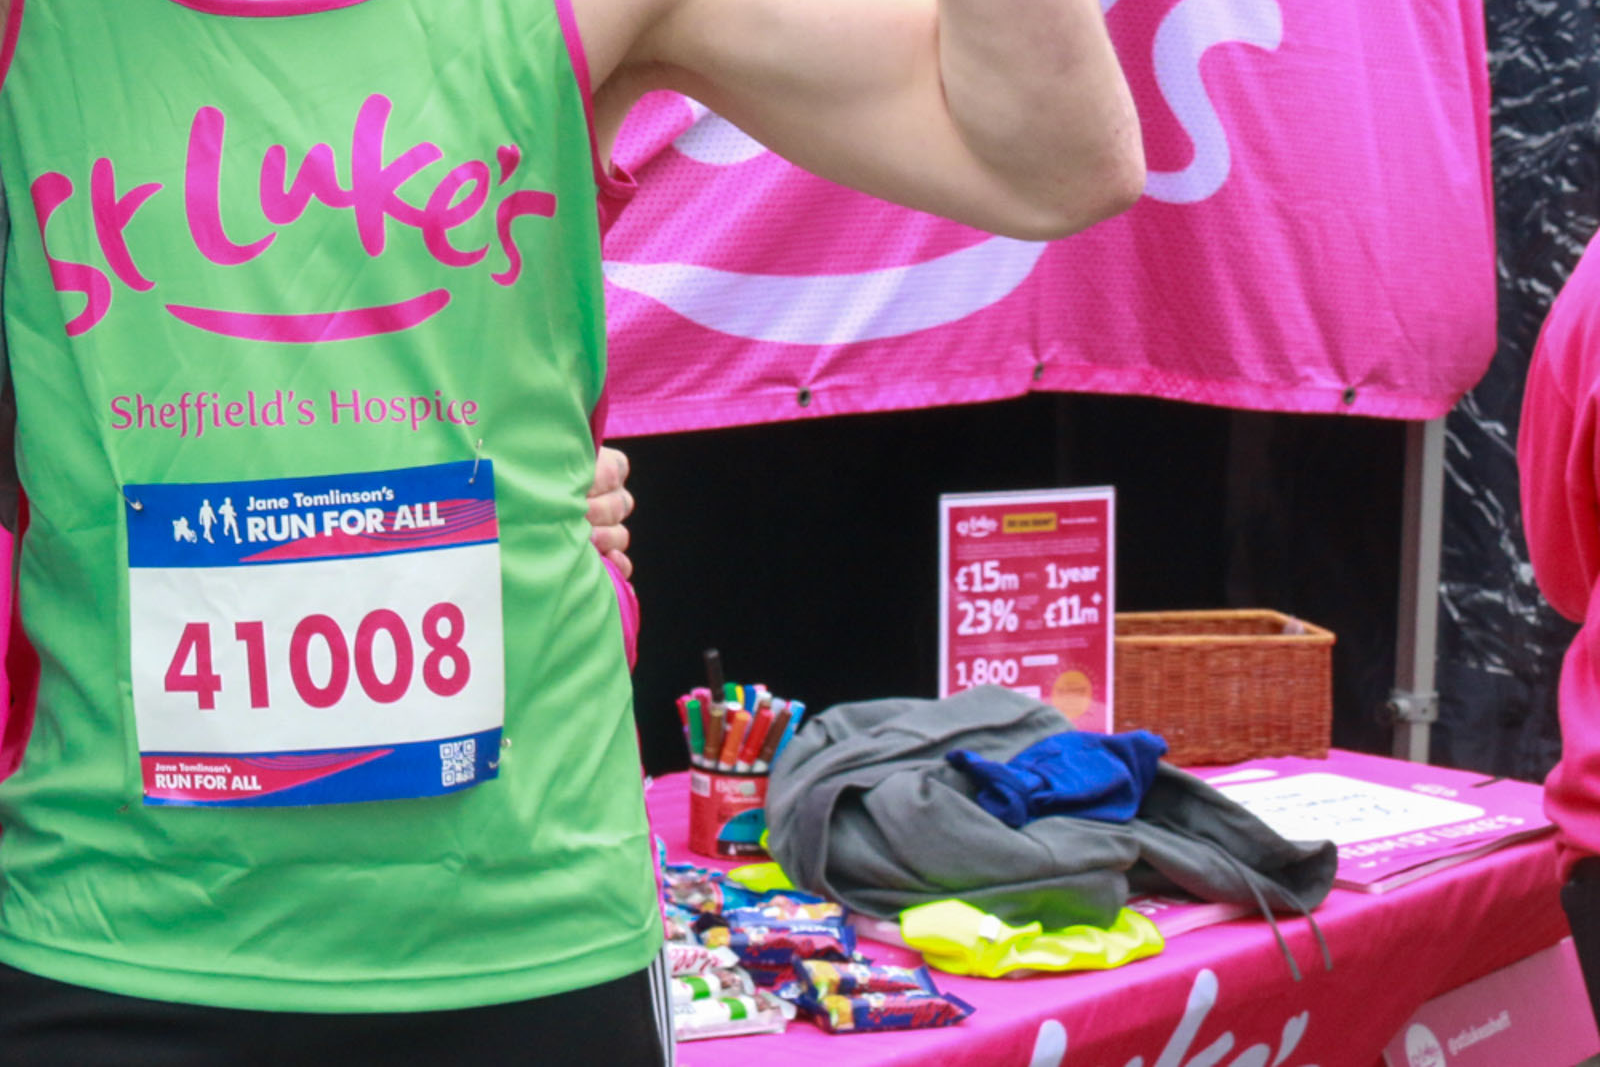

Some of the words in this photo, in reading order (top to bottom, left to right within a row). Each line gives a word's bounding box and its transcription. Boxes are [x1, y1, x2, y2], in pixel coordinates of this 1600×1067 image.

[30, 156, 164, 338] St
[184, 93, 558, 287] Luke's
[110, 390, 316, 438] Sheffield's
[330, 389, 480, 432] Hospice
[246, 496, 290, 512] Jane
[293, 486, 395, 509] Tomlinson's
[246, 515, 316, 543] RUN
[323, 509, 386, 538] FOR
[393, 501, 446, 532] ALL
[956, 598, 1019, 636] 23%
[164, 601, 472, 711] 41008
[155, 762, 177, 773] Jane
[178, 762, 232, 774] Tomlinson's
[155, 774, 192, 790] RUN
[194, 775, 228, 791] FOR
[231, 775, 262, 791] ALL
